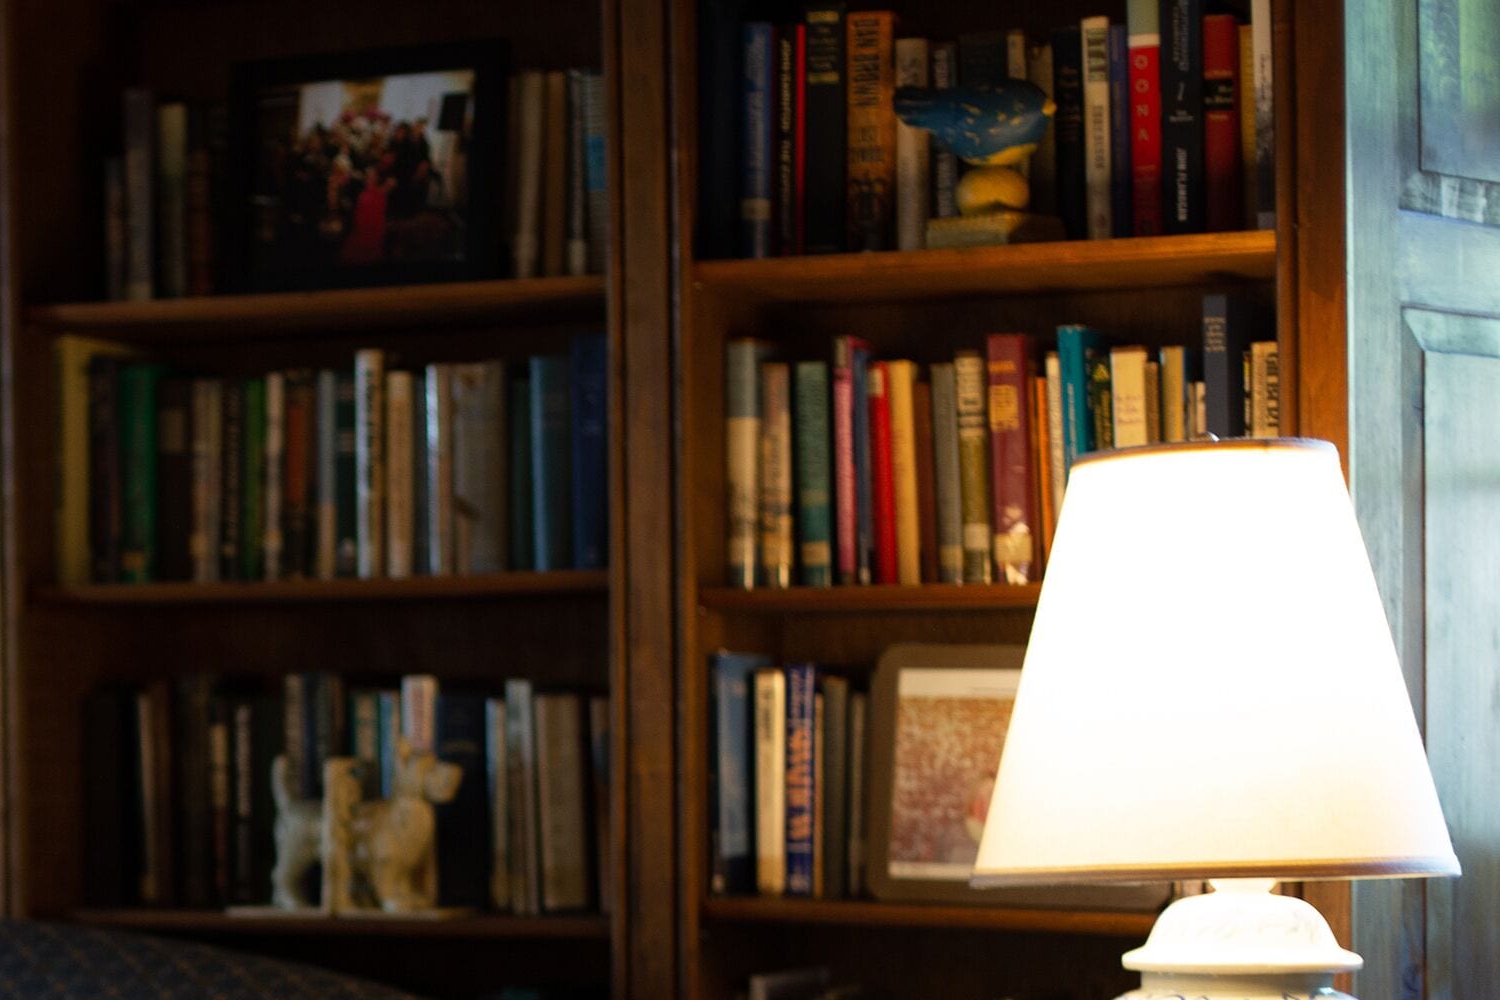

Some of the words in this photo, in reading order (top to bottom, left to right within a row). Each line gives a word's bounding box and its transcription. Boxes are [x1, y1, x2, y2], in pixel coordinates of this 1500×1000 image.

[854, 19, 881, 48] DAN
[853, 54, 881, 107] BROWN
[1134, 54, 1150, 144] OONA
[1175, 147, 1188, 171] JOHN
